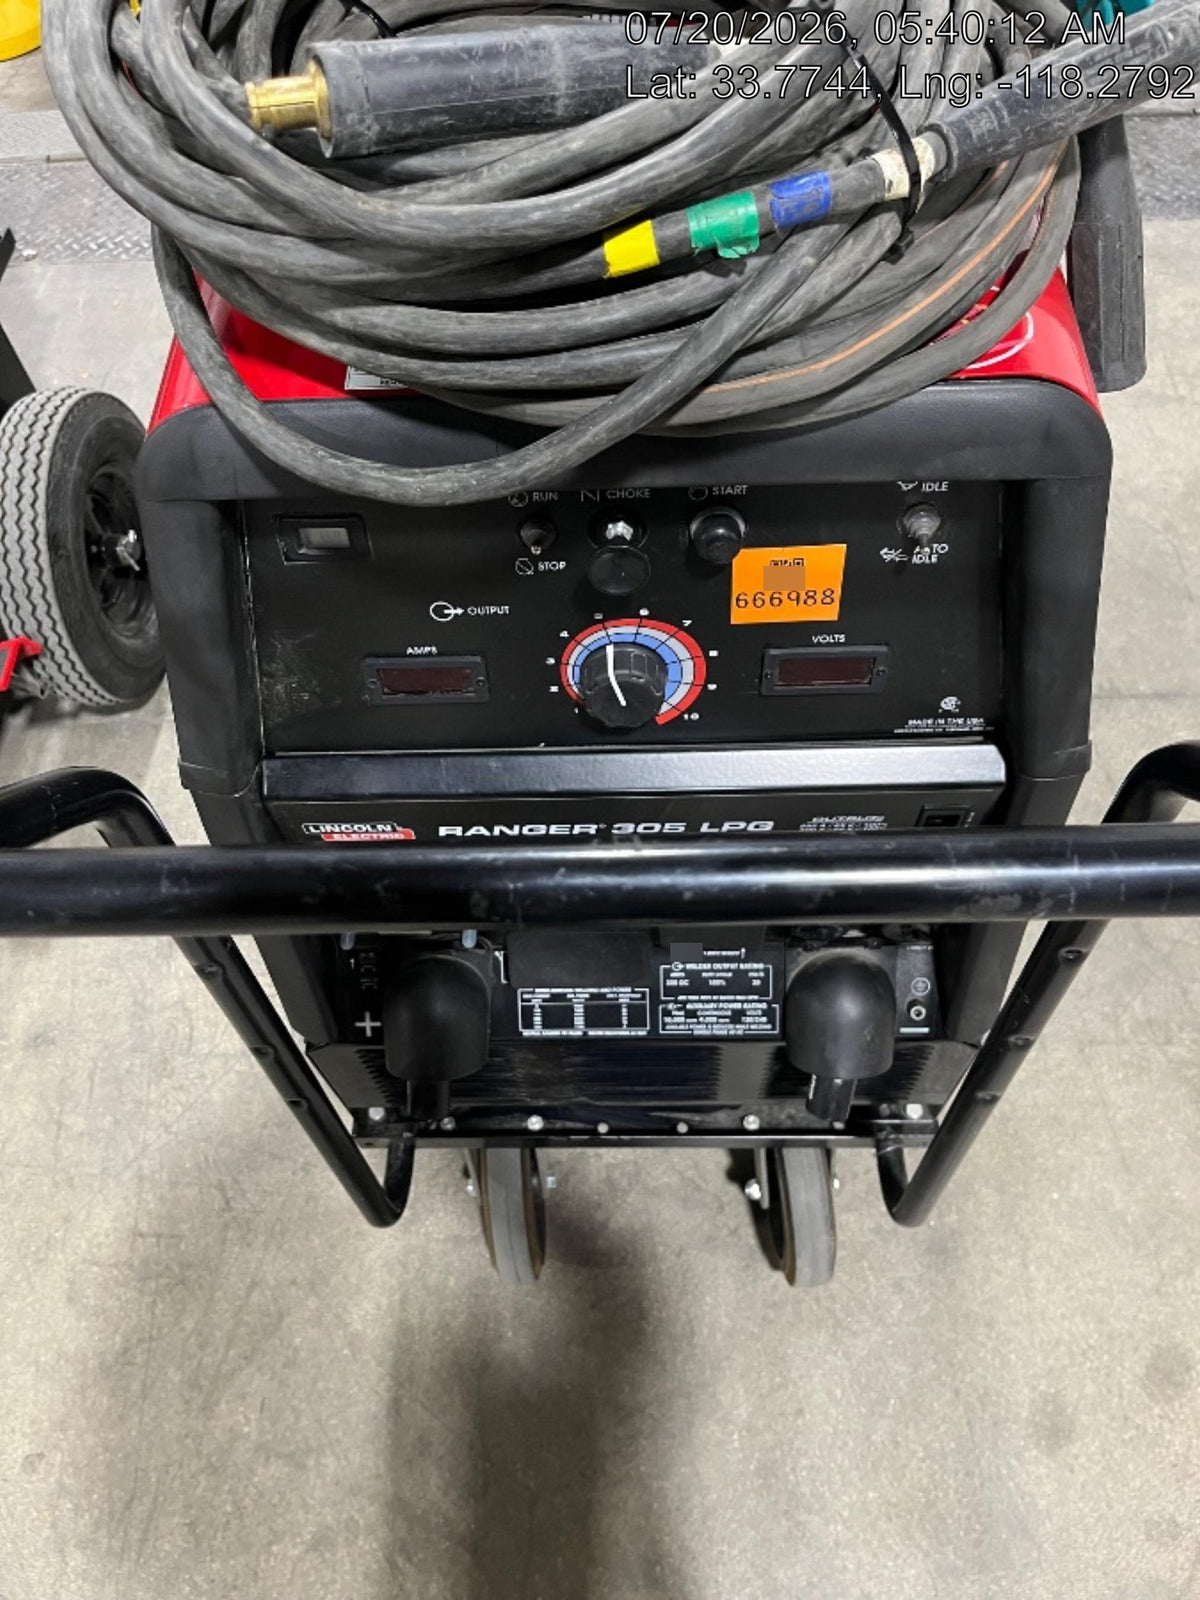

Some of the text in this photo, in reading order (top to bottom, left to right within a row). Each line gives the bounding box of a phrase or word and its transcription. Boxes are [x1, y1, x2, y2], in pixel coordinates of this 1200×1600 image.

[712, 485, 748, 496] START
[921, 481, 949, 492] IDLE
[532, 491, 559, 502] RUN
[605, 488, 651, 500] CHOKE
[912, 543, 949, 554] ATO
[911, 554, 939, 565] IDLE
[538, 561, 566, 572] STOP
[735, 588, 836, 609] 666988
[467, 605, 510, 616] OUTPUT
[812, 634, 846, 644] VOLTS
[406, 646, 438, 655] AMPS
[308, 824, 393, 833] LINCOLN
[611, 822, 687, 834] 305
[700, 821, 775, 833] LPG
[332, 832, 406, 840] ELECTRIC
